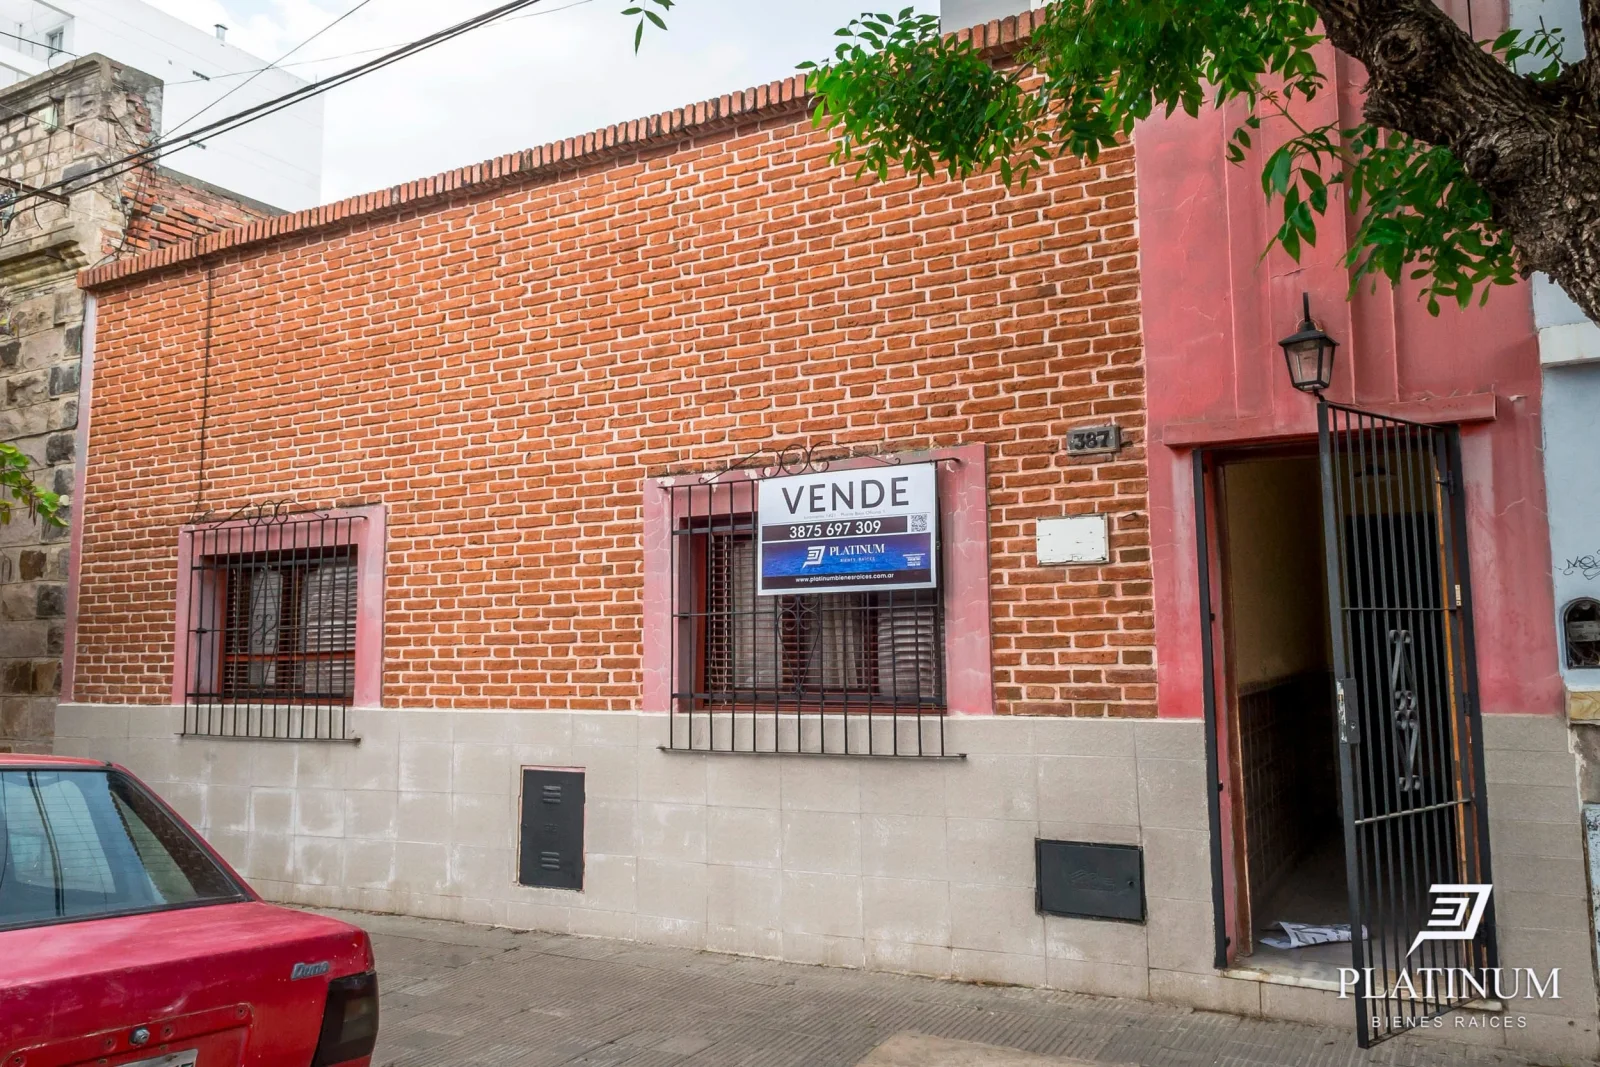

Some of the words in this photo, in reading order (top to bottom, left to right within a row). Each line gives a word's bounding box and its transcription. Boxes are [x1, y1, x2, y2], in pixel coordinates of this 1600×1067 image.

[1073, 430, 1110, 450] 387
[781, 476, 909, 515] VENDE
[789, 524, 822, 539] 3875
[826, 522, 851, 536] 697
[855, 520, 882, 534] 309
[829, 543, 885, 557] PLATINUM
[795, 572, 895, 584] www.platinumbienesraices.com.ar
